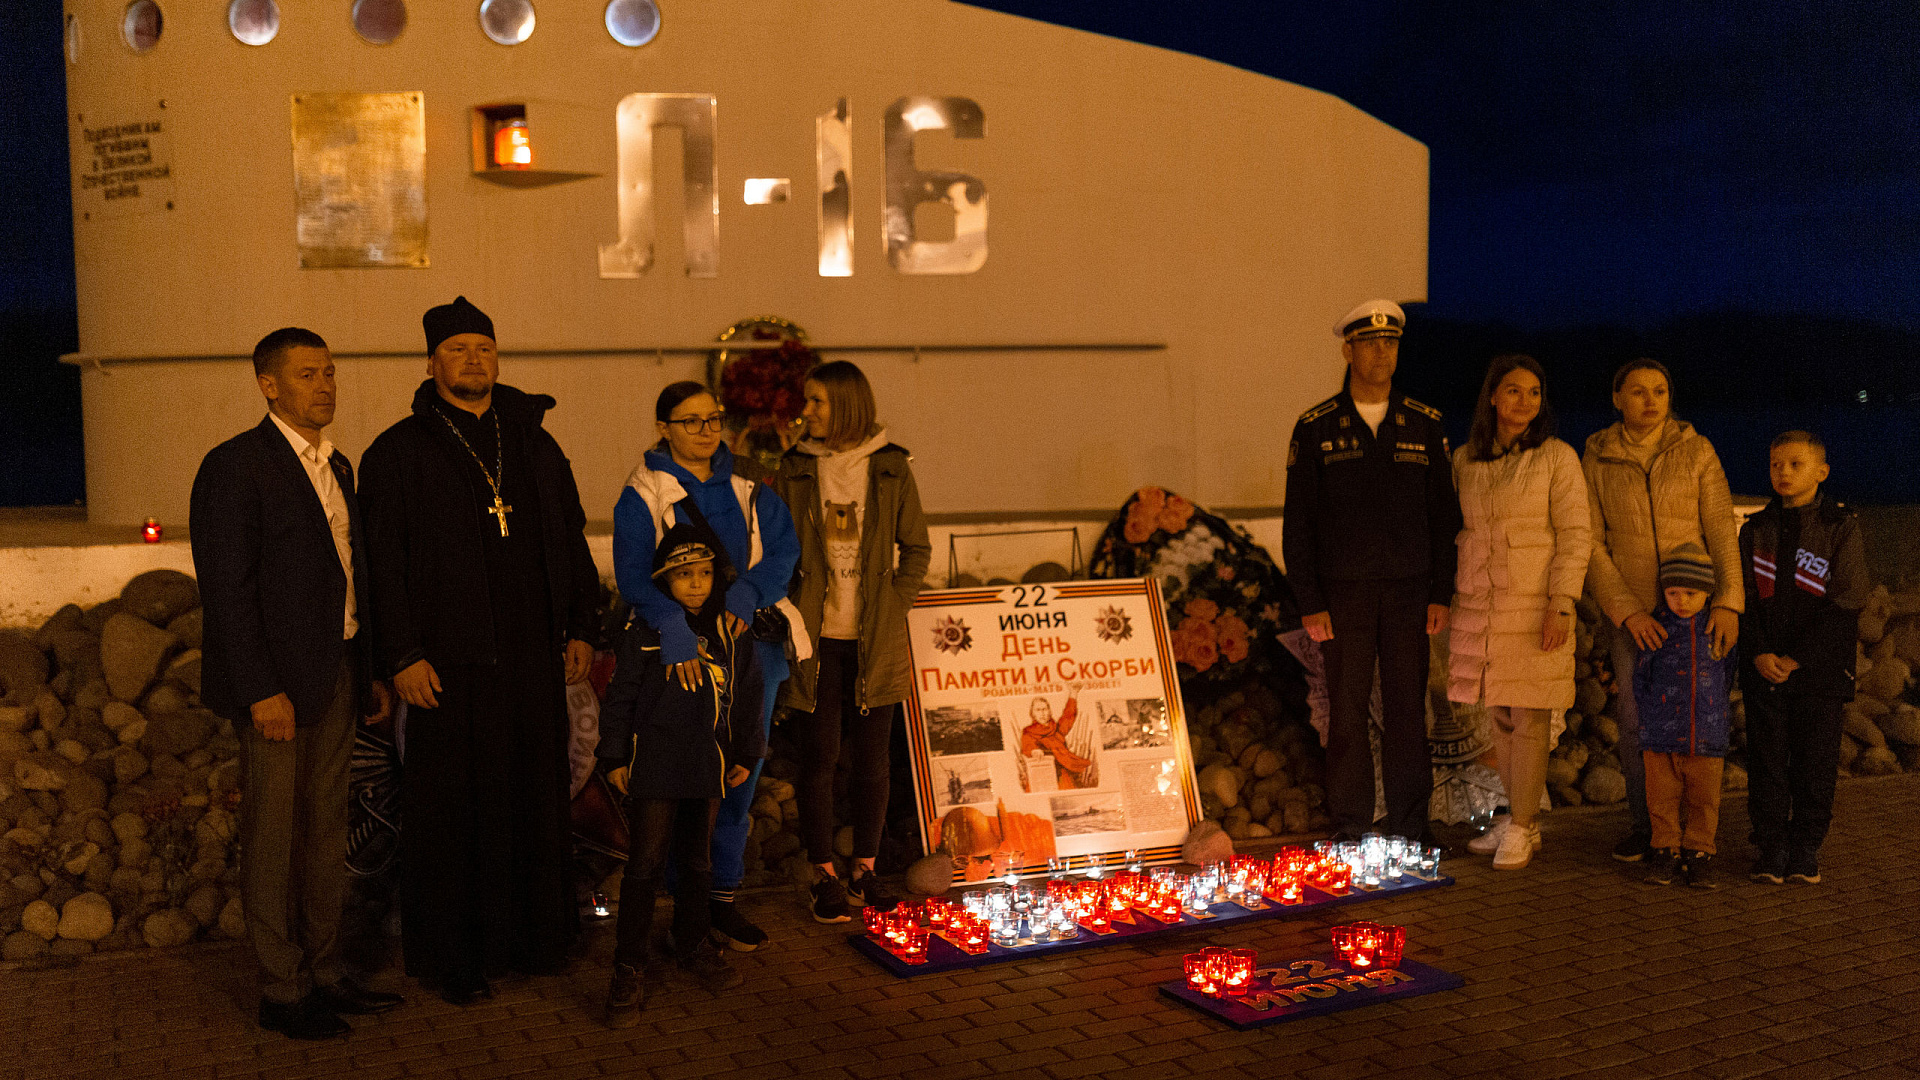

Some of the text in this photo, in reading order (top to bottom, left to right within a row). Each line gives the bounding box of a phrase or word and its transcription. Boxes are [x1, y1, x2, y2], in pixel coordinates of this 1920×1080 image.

[598, 93, 989, 279] Л-16
[1011, 585, 1048, 608] 22
[999, 611, 1068, 631] ИЮНЯ
[1427, 735, 1478, 756] ОБЕДА
[1255, 960, 1345, 987] 22
[1236, 968, 1415, 1012] ИЮНЯ
